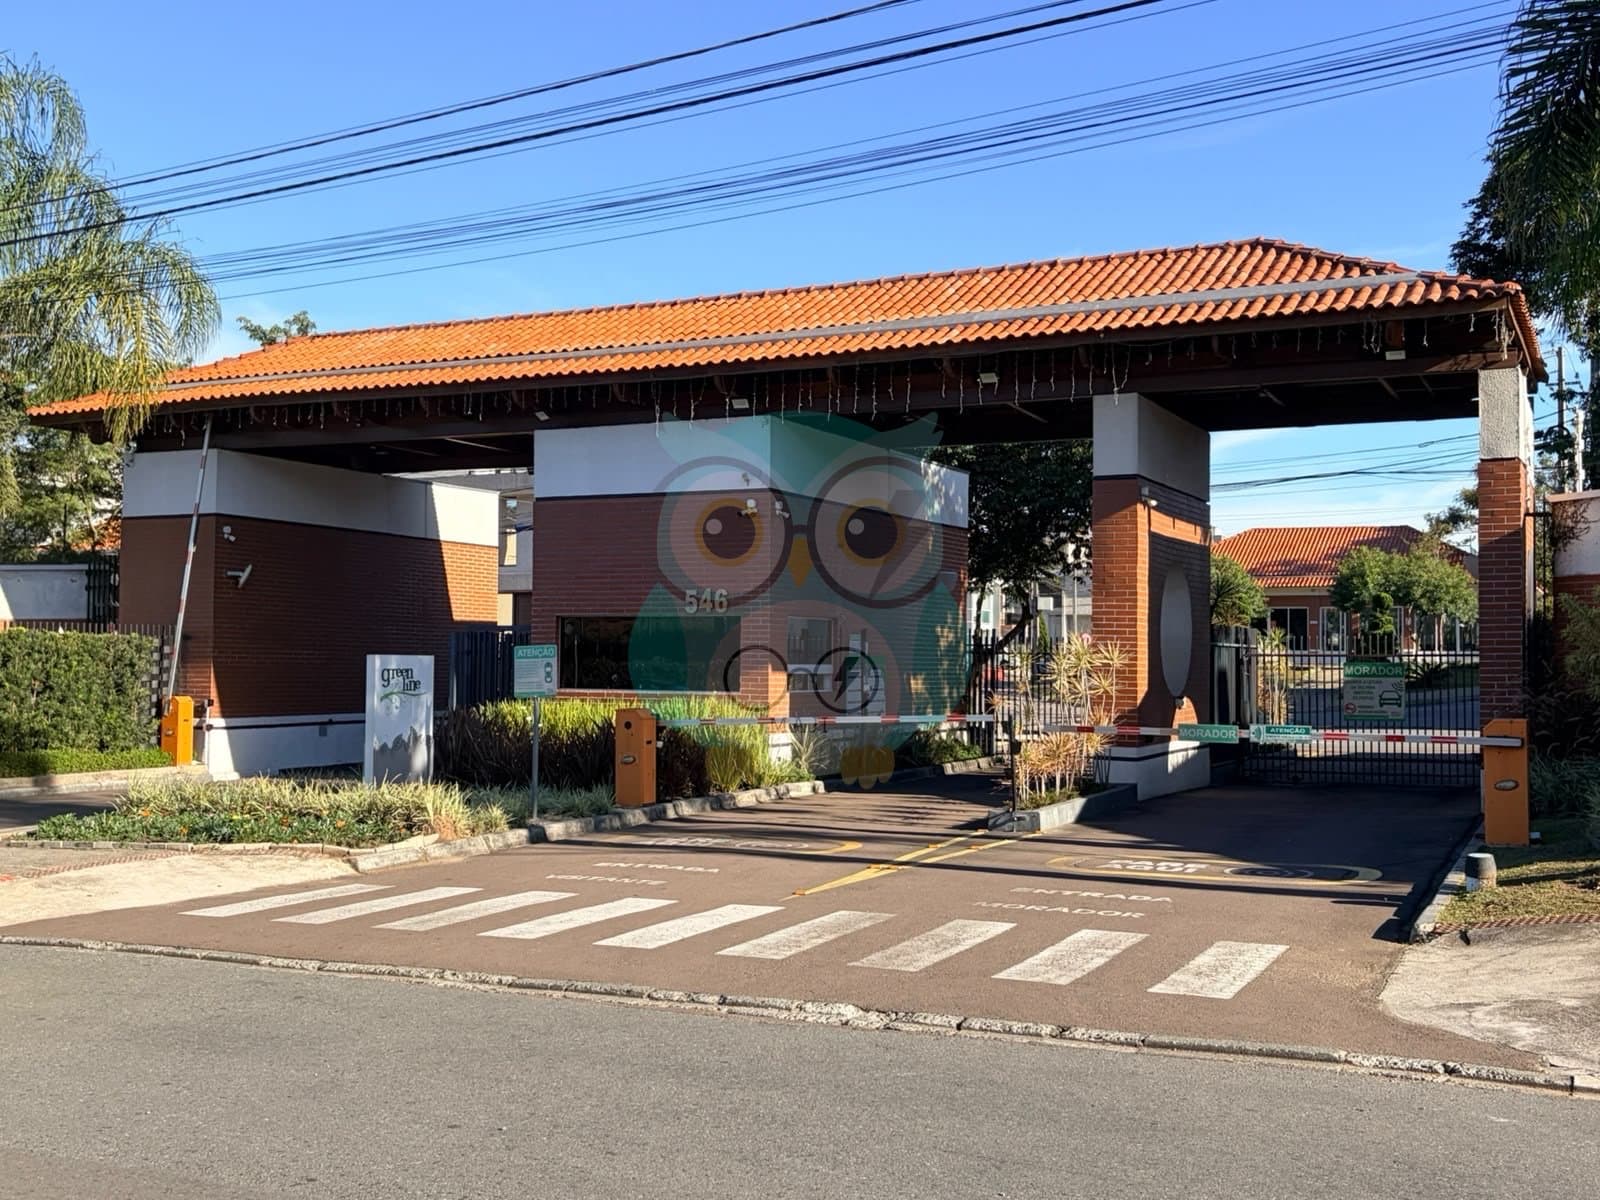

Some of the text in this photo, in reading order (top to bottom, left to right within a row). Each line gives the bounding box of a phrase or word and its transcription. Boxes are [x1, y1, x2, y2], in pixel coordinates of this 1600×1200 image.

[685, 588, 728, 614] 546
[1344, 665, 1403, 676] MORADOR
[381, 667, 414, 688] green
[402, 676, 421, 691] line
[1180, 728, 1237, 739] MORADOR
[1270, 726, 1306, 735] ATENÇÃO
[593, 862, 720, 873] ENTRADA
[545, 874, 670, 885] VISITANTE
[1009, 887, 1174, 902] ENTRADA
[972, 901, 1145, 918] MORADOR
